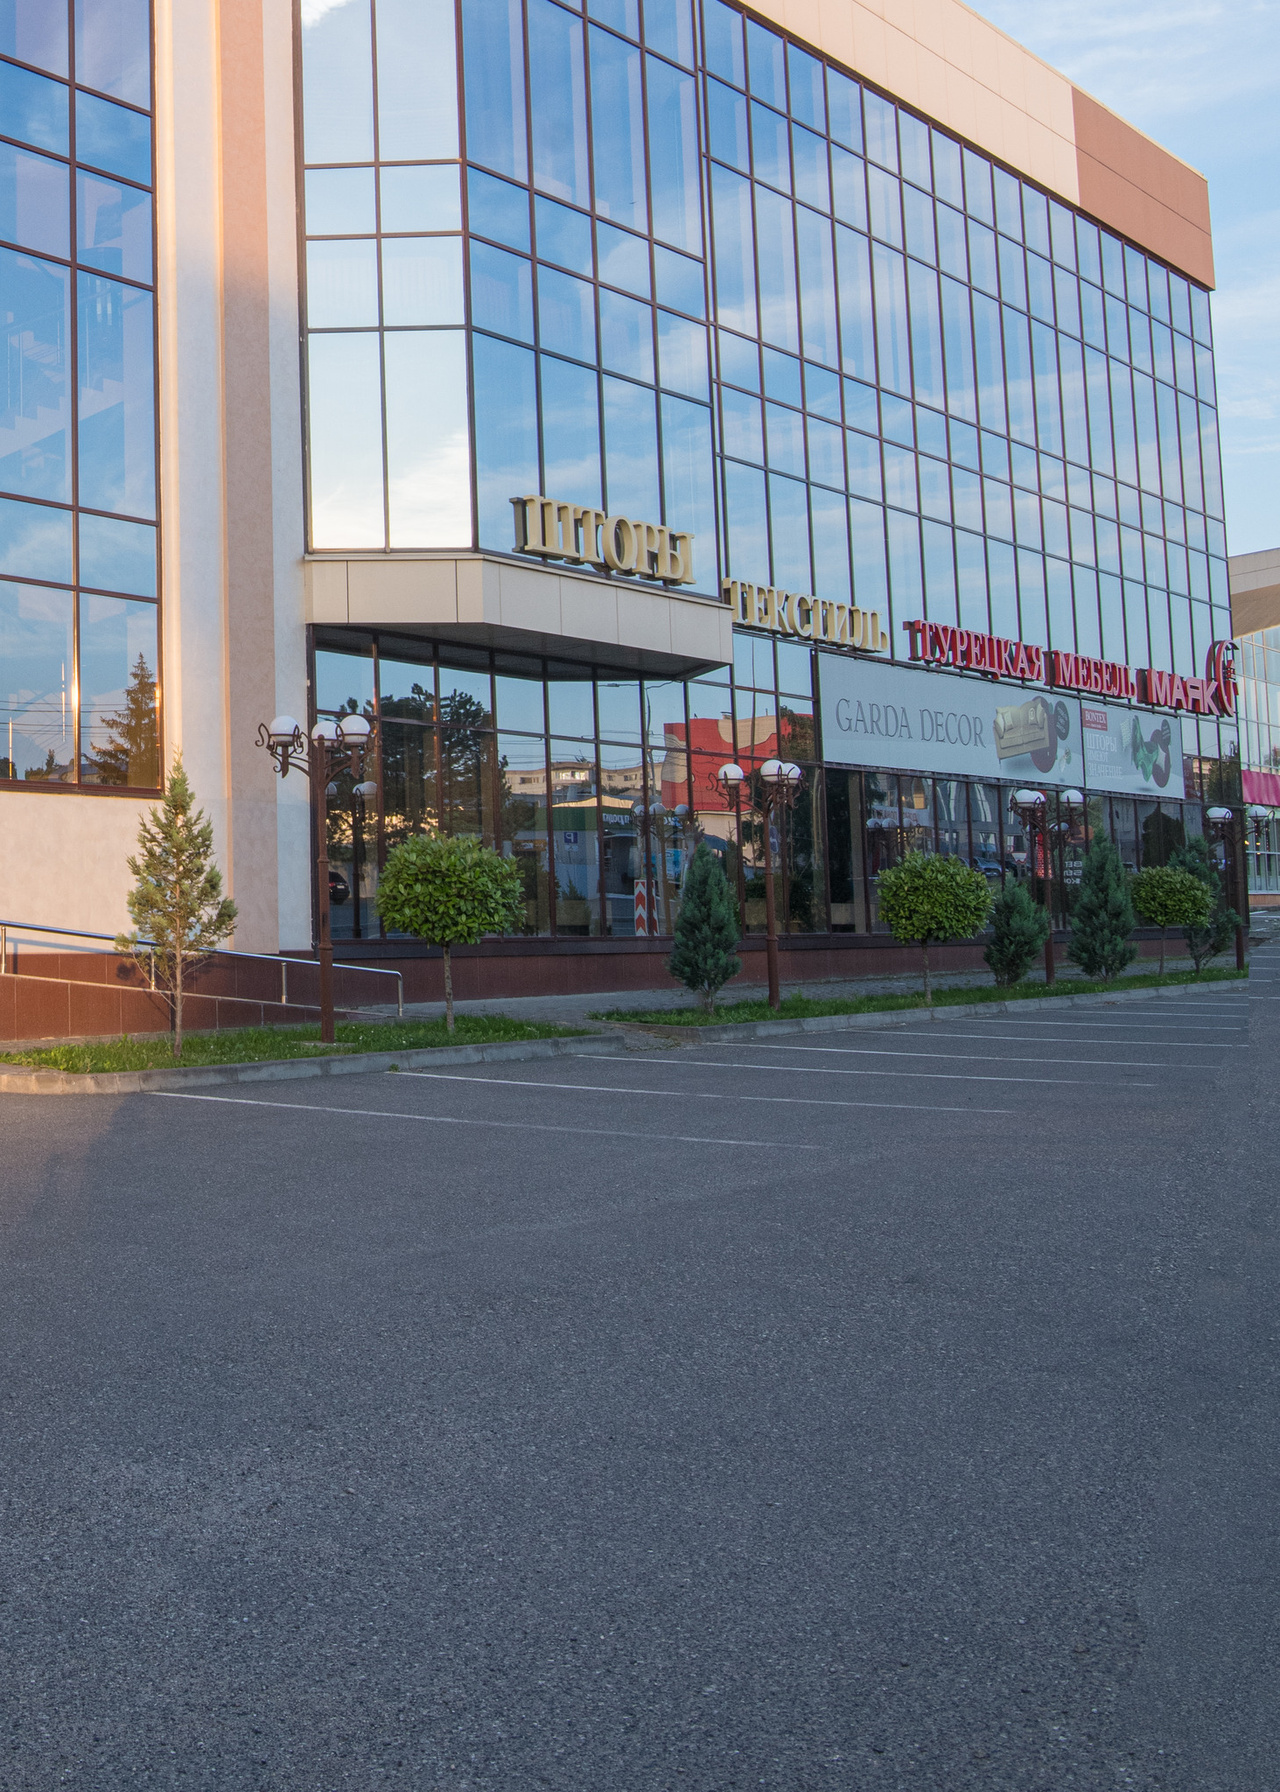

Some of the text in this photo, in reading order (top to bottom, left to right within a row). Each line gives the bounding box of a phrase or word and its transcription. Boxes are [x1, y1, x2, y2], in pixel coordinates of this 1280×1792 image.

[522, 494, 696, 586] ШТОРЫ
[724, 577, 889, 654] ТЕКСТИЛЬ
[919, 620, 1219, 716] ТУРЕЦКАЯ МЕБЕЛЬ МАЯК
[834, 697, 987, 749] GARDA DECOR
[1085, 711, 1107, 724] BONTEX
[1086, 733, 1118, 752] ШТОРЫ
